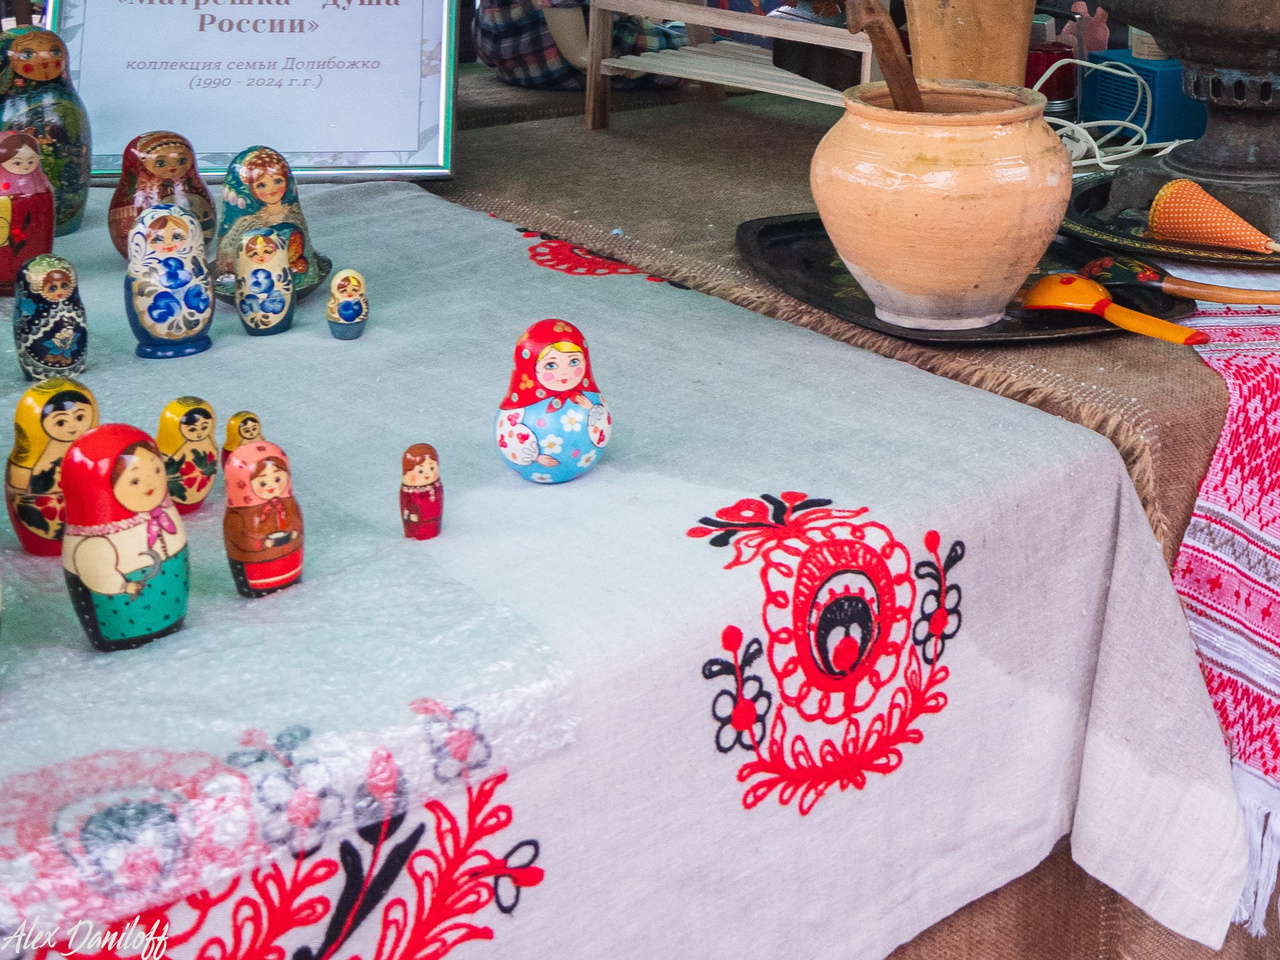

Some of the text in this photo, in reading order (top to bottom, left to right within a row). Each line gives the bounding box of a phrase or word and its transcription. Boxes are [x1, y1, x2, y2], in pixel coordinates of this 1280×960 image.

[198, 13, 320, 33] России»
[126, 56, 381, 72] коллекция семьи Долибожко
[188, 75, 232, 89] (1990
[246, 76, 284, 89] 2024
[287, 74, 324, 90] г.г.)
